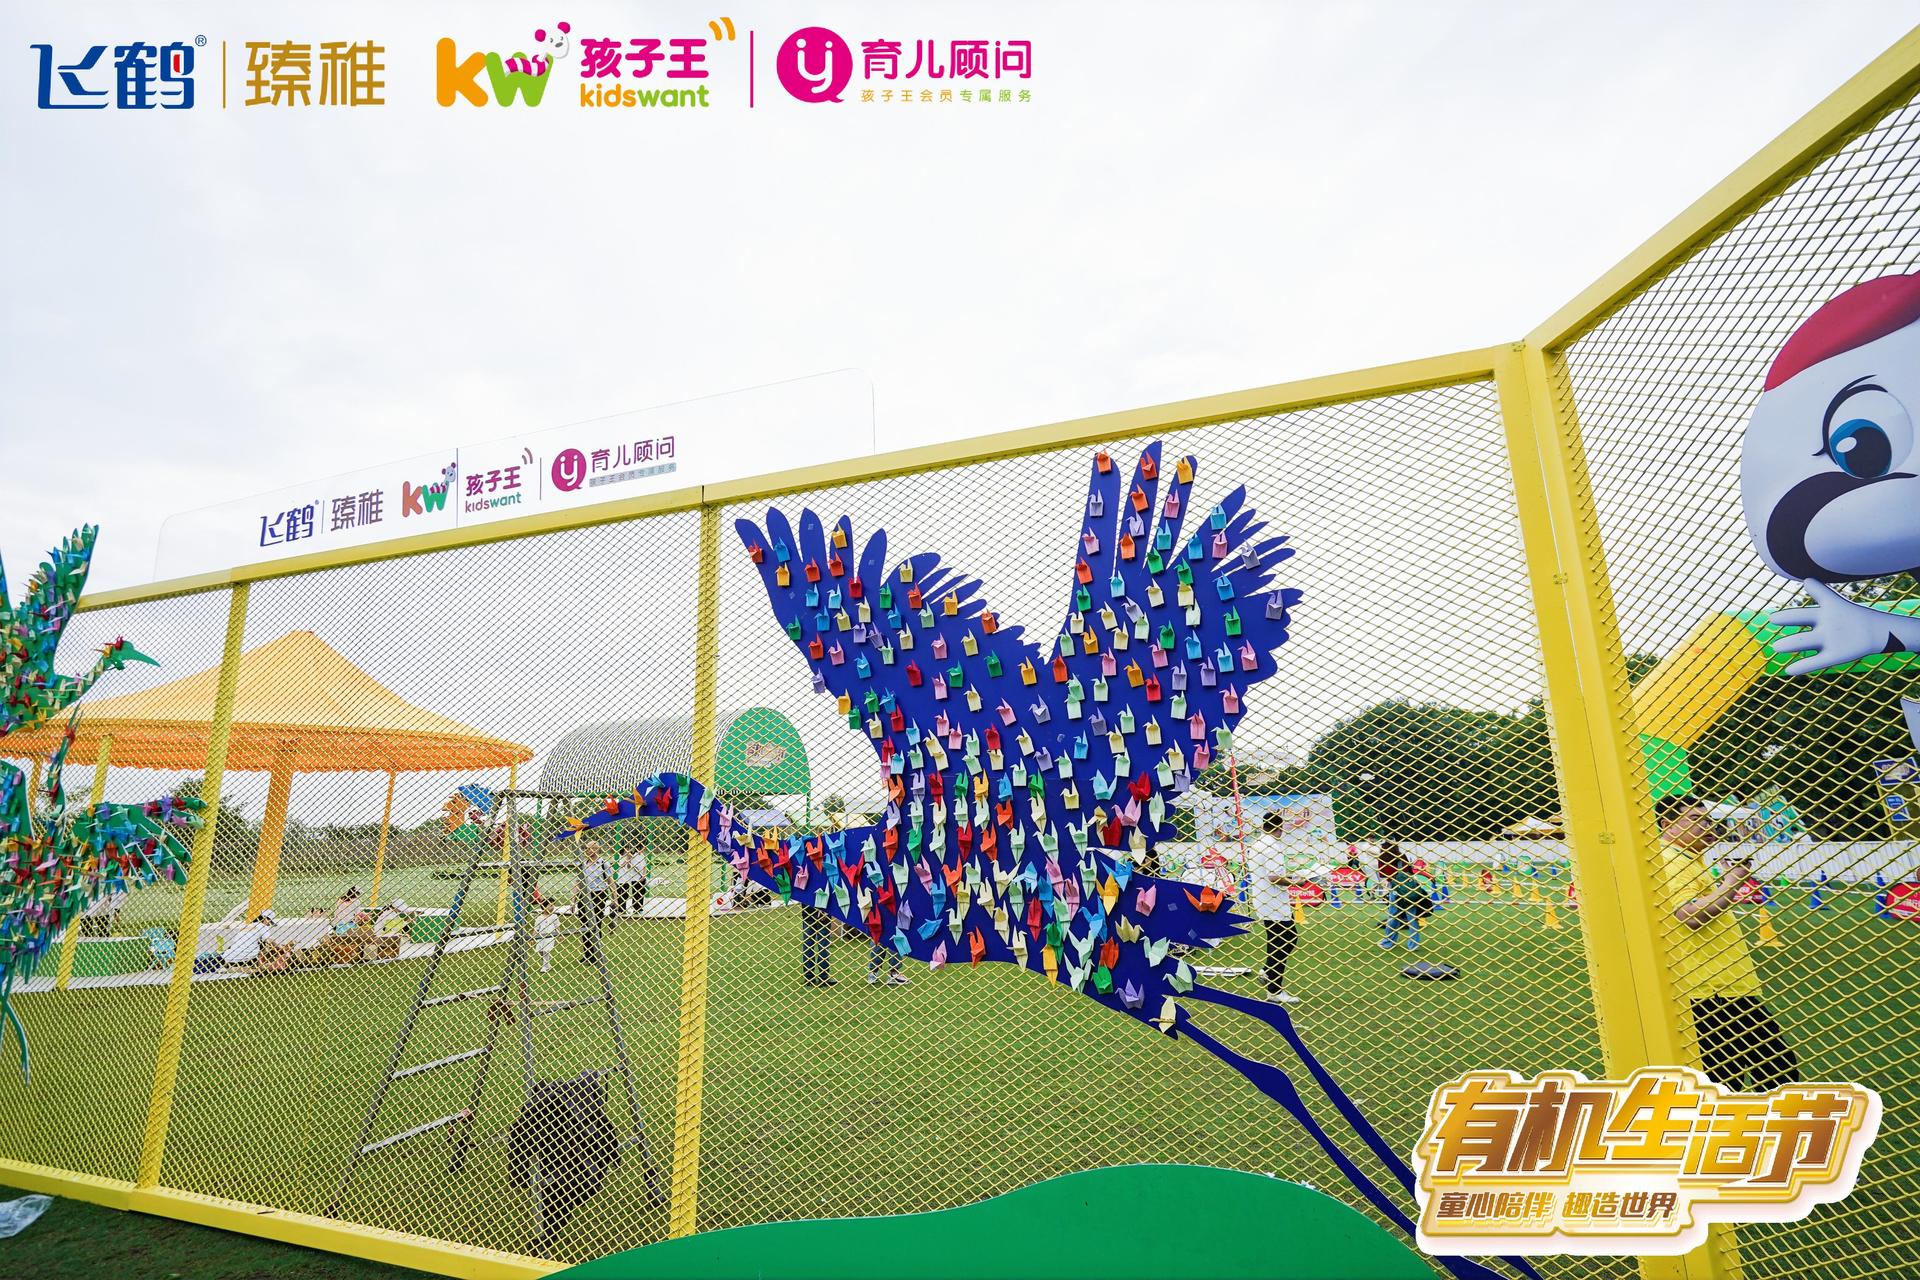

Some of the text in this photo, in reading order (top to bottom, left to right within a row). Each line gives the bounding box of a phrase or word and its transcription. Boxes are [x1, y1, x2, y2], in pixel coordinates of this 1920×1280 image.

[590, 436, 675, 473] 育儿顾问
[466, 465, 522, 497] 孩子王
[330, 489, 384, 531] 臻稚
[465, 492, 522, 513] kidswant
[259, 504, 315, 547] 飞鹤
